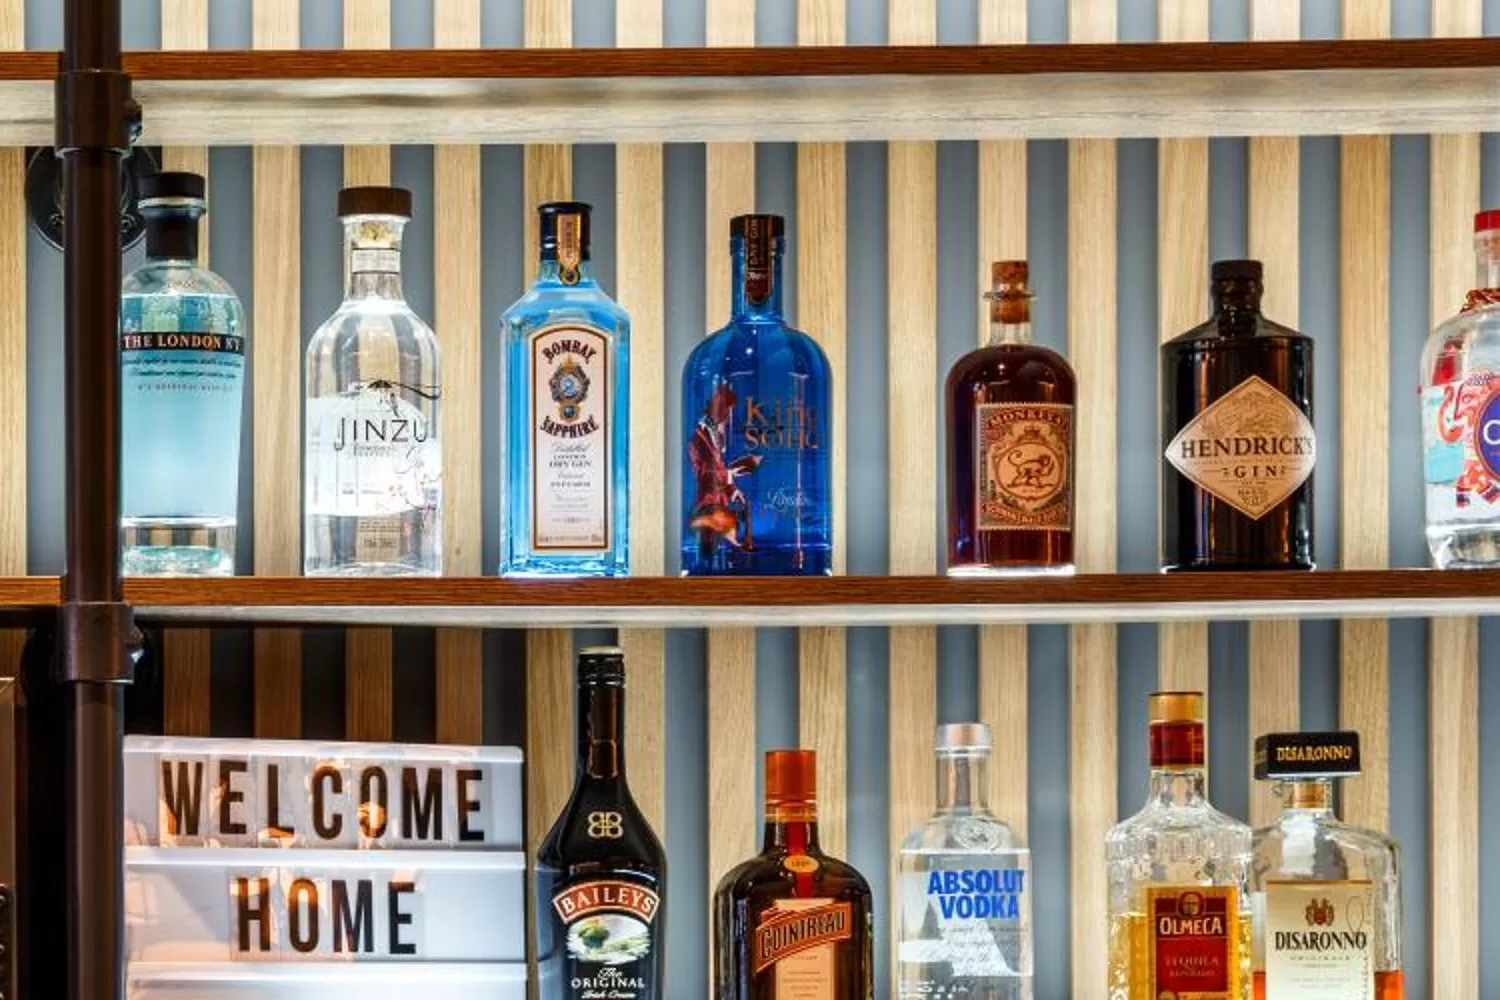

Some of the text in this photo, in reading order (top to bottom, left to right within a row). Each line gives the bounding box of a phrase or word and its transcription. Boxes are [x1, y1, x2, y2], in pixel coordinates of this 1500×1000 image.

[123, 335, 153, 349] THE
[158, 333, 221, 349] LONDON
[542, 340, 596, 364] BOMBAY
[333, 417, 428, 451] JINZU
[540, 415, 599, 438] SAPPHIRE
[1181, 434, 1313, 459] HENDRICK'S
[1233, 465, 1278, 479] GIN
[1276, 745, 1353, 760] DISARONNO
[161, 759, 486, 842] WELCOME
[928, 868, 1026, 896] ABSOLUT
[561, 887, 655, 914] BAILEYS
[938, 896, 1021, 919] VODKA
[235, 877, 418, 955] HOME
[1160, 917, 1224, 936] OLMECA
[761, 911, 845, 960] COINTREAU
[1275, 931, 1368, 952] DISARONNO
[571, 977, 646, 990] ORIGINAL
